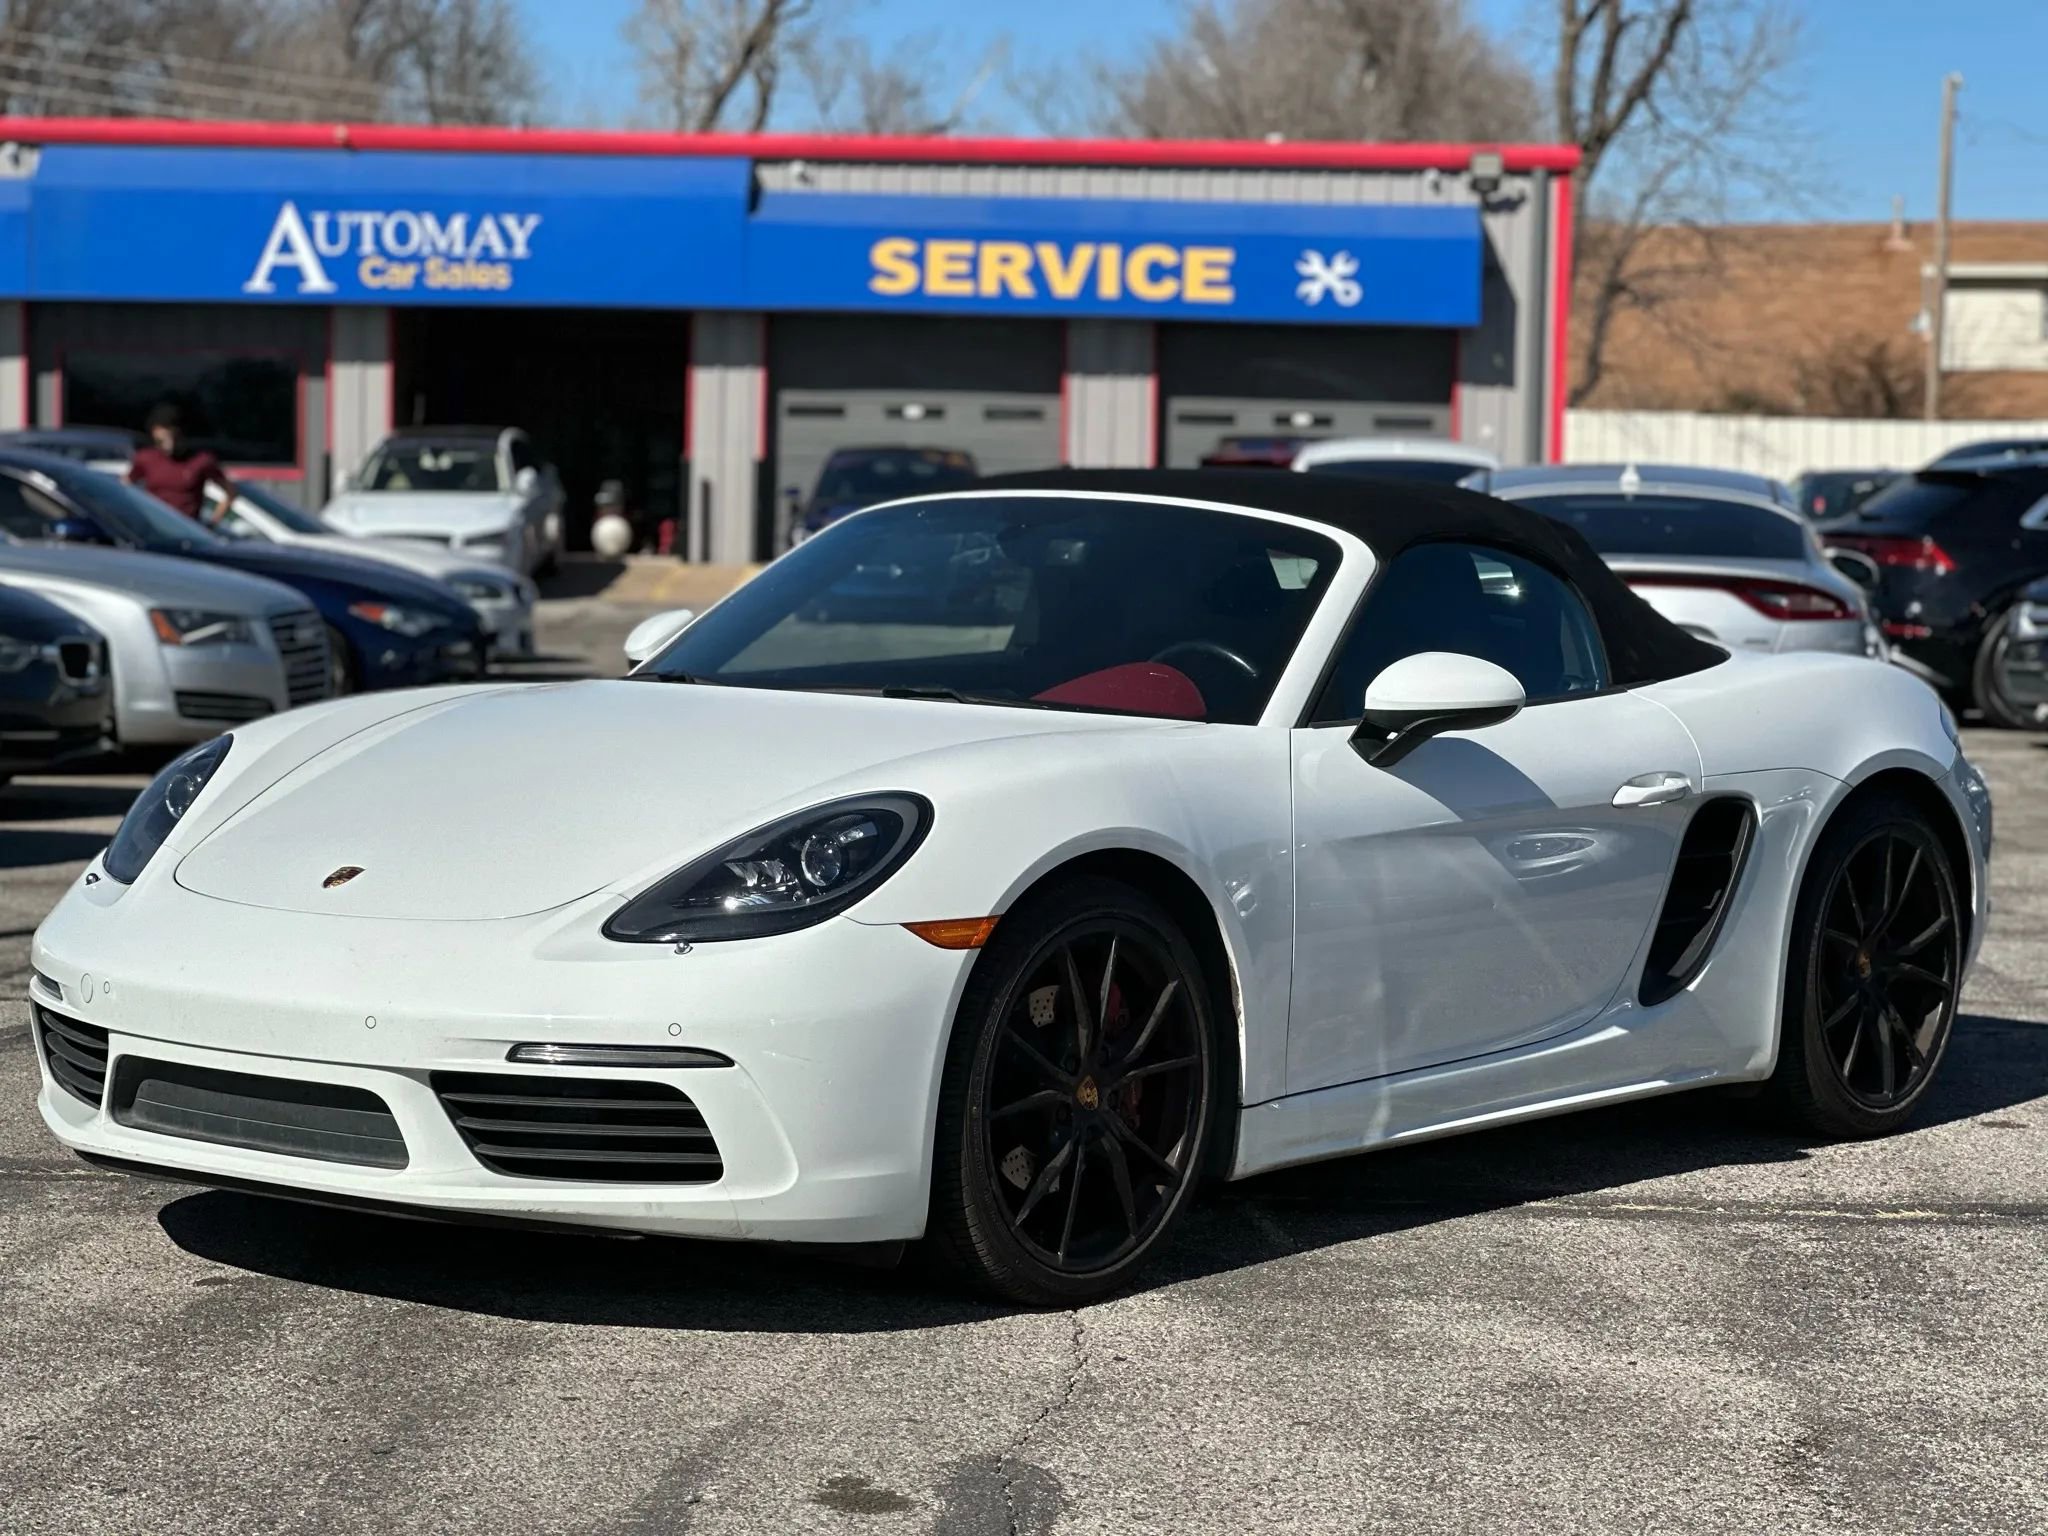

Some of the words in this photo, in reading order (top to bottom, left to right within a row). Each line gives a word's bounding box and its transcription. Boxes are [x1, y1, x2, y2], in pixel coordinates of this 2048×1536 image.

[243, 201, 541, 293] AUTOMAY
[358, 255, 419, 289] Car
[424, 255, 512, 290] Sales
[869, 237, 1235, 303] SERVICE
